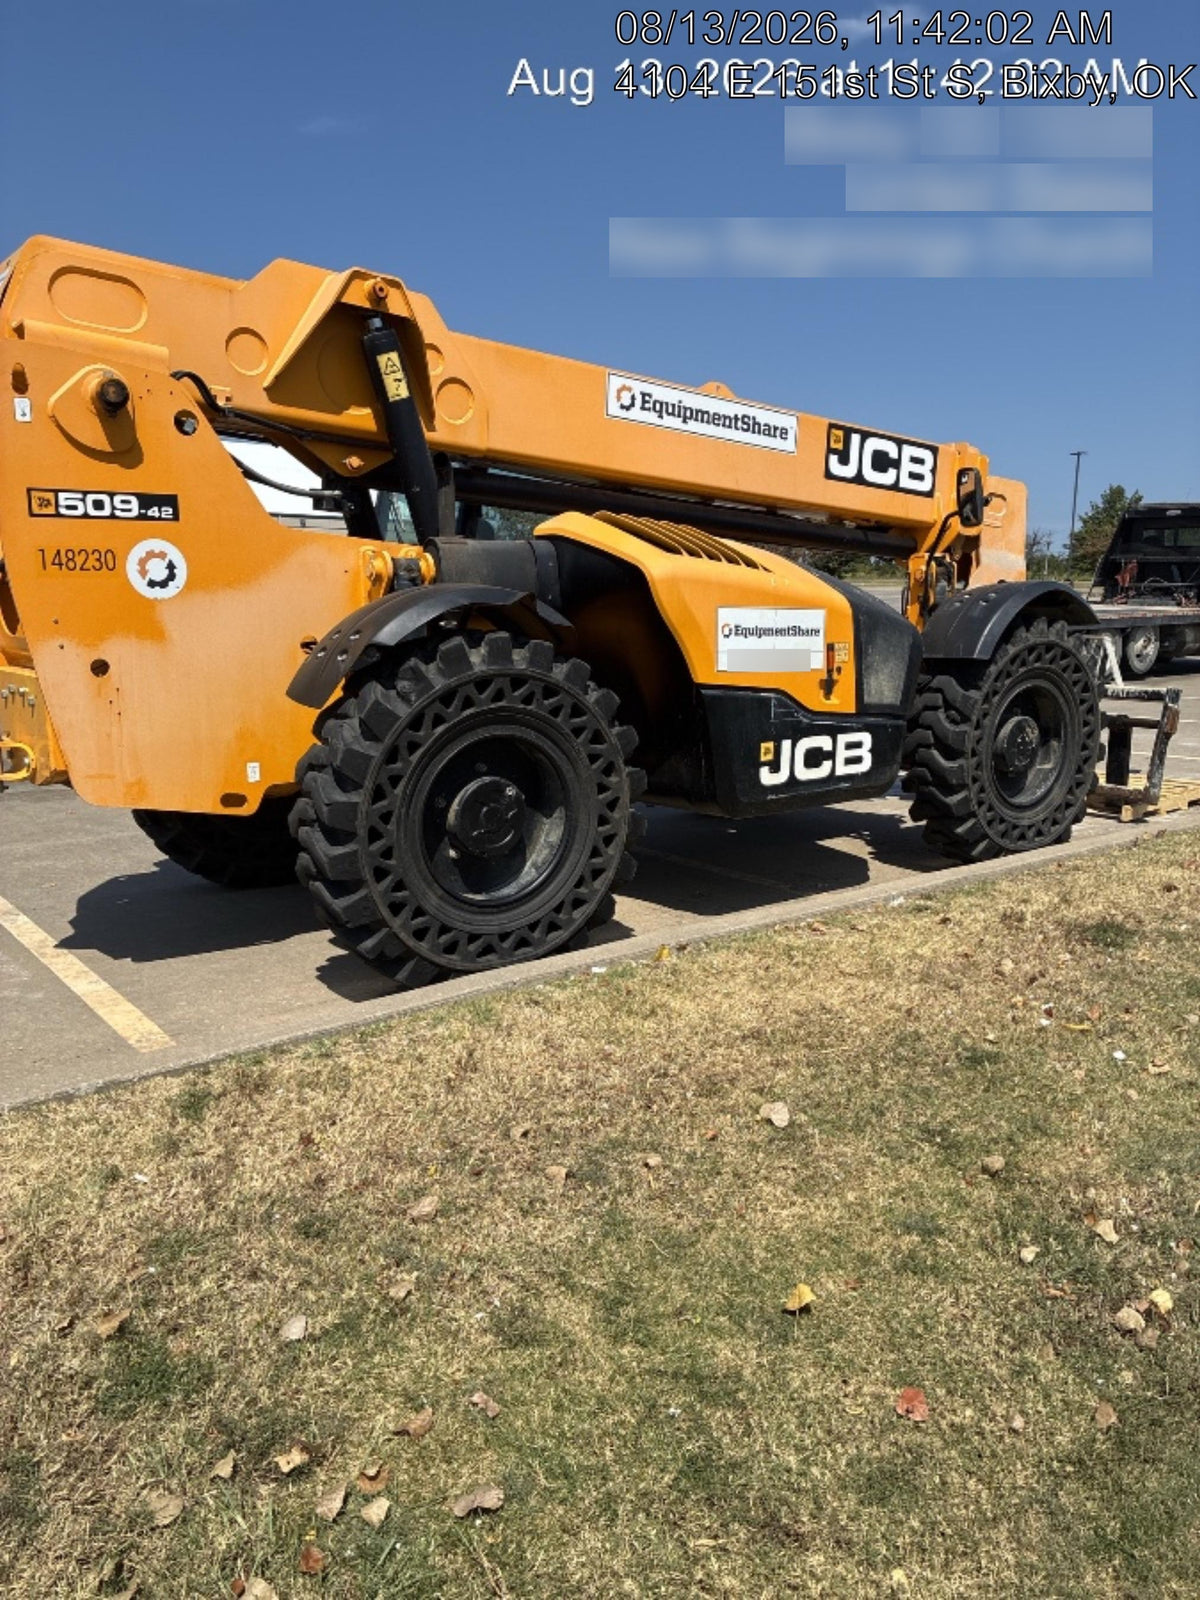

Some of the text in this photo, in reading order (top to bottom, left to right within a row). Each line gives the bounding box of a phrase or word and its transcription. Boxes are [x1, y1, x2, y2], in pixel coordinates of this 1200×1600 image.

[640, 391, 789, 441] EquipmentShare
[828, 433, 935, 492] JCB
[58, 492, 173, 518] 509-42
[38, 549, 117, 571] 148230
[734, 624, 820, 638] EquipmentShare
[759, 732, 872, 786] JCB
